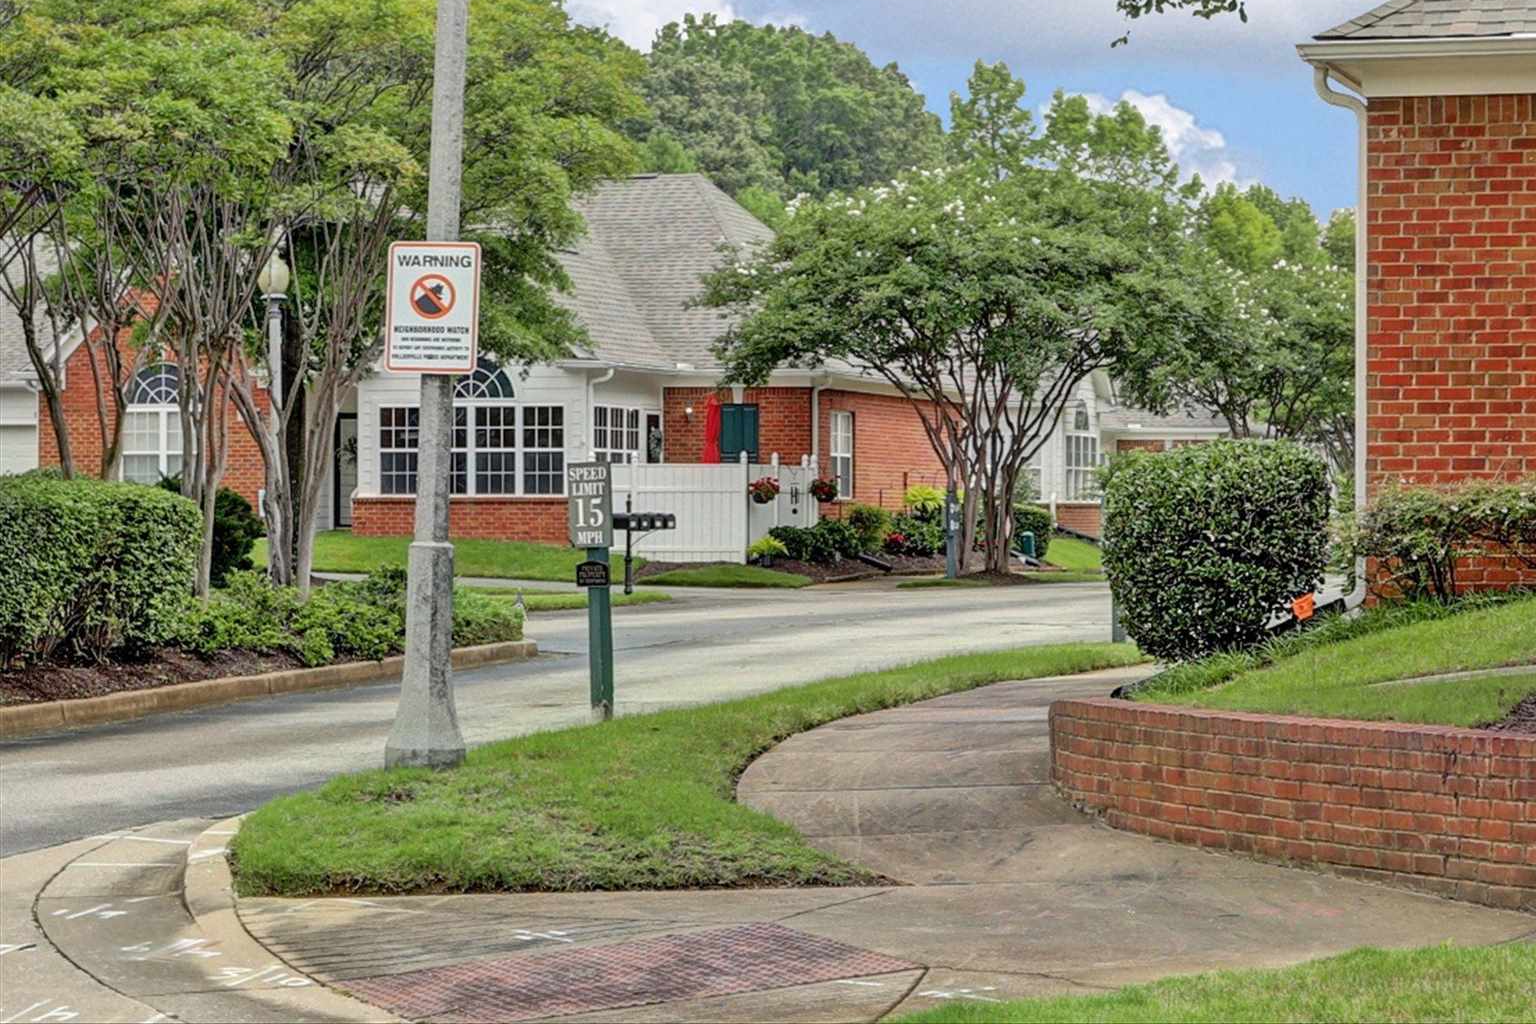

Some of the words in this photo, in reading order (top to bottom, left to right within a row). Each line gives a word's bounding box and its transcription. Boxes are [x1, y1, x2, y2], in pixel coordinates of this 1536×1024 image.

[398, 255, 472, 268] WARNING
[569, 467, 607, 481] SPEED
[572, 482, 605, 496] LIMIT
[576, 497, 604, 527] 15
[577, 531, 603, 545] MPH
